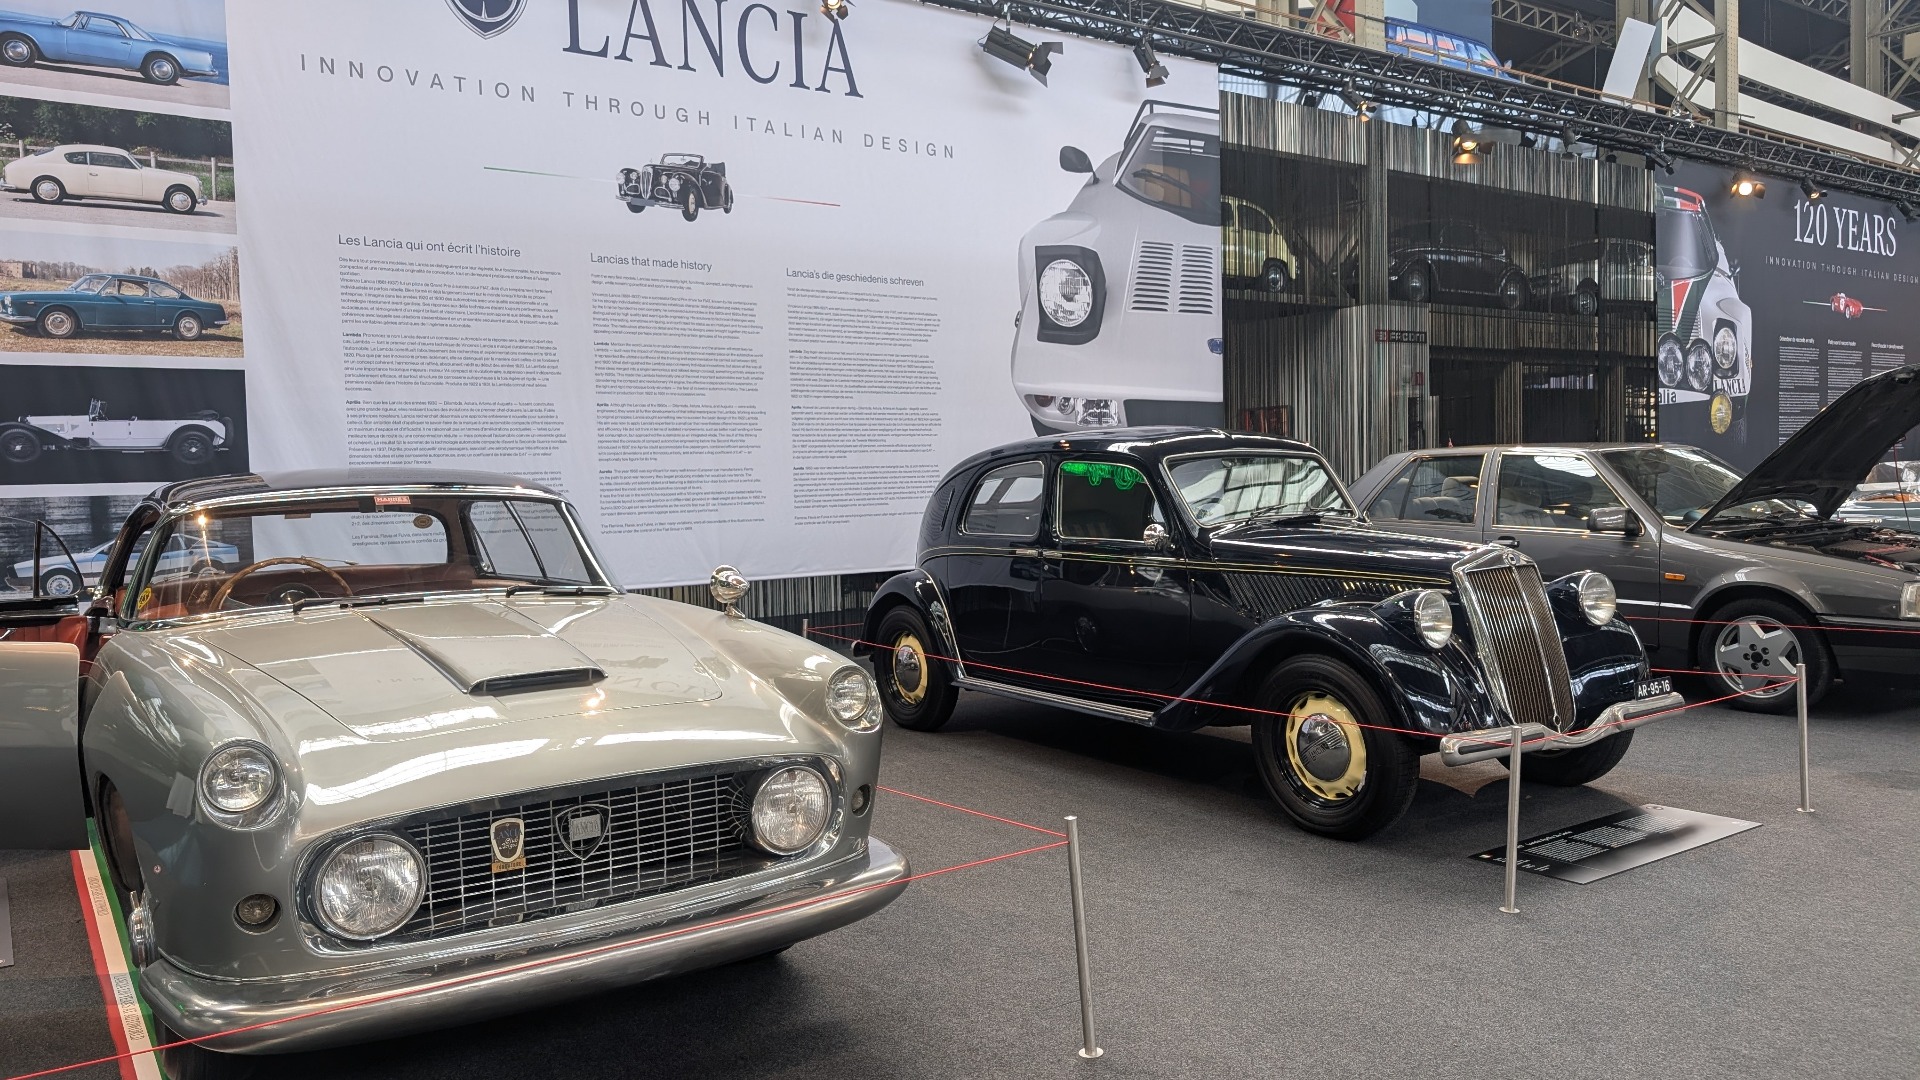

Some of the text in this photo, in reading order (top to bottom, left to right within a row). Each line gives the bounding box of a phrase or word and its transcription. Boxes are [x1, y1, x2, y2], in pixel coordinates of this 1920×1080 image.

[563, 0, 863, 98] LANCIA
[300, 53, 954, 159] INNOVATION THROUGH ITALIAN DESIGN
[1794, 199, 1897, 257] 120 YEARS
[338, 234, 521, 257] Les Lancia qui ont écrit l'histoire
[590, 253, 713, 273] Lancias that made history
[1765, 255, 1919, 284] INNOVATION THROUGH ITALIAN DESIGN
[786, 268, 924, 287] Lancia's die geschiedenis schreven
[1714, 378, 1747, 394] LANCIA
[1637, 679, 1671, 698] AR-95-16
